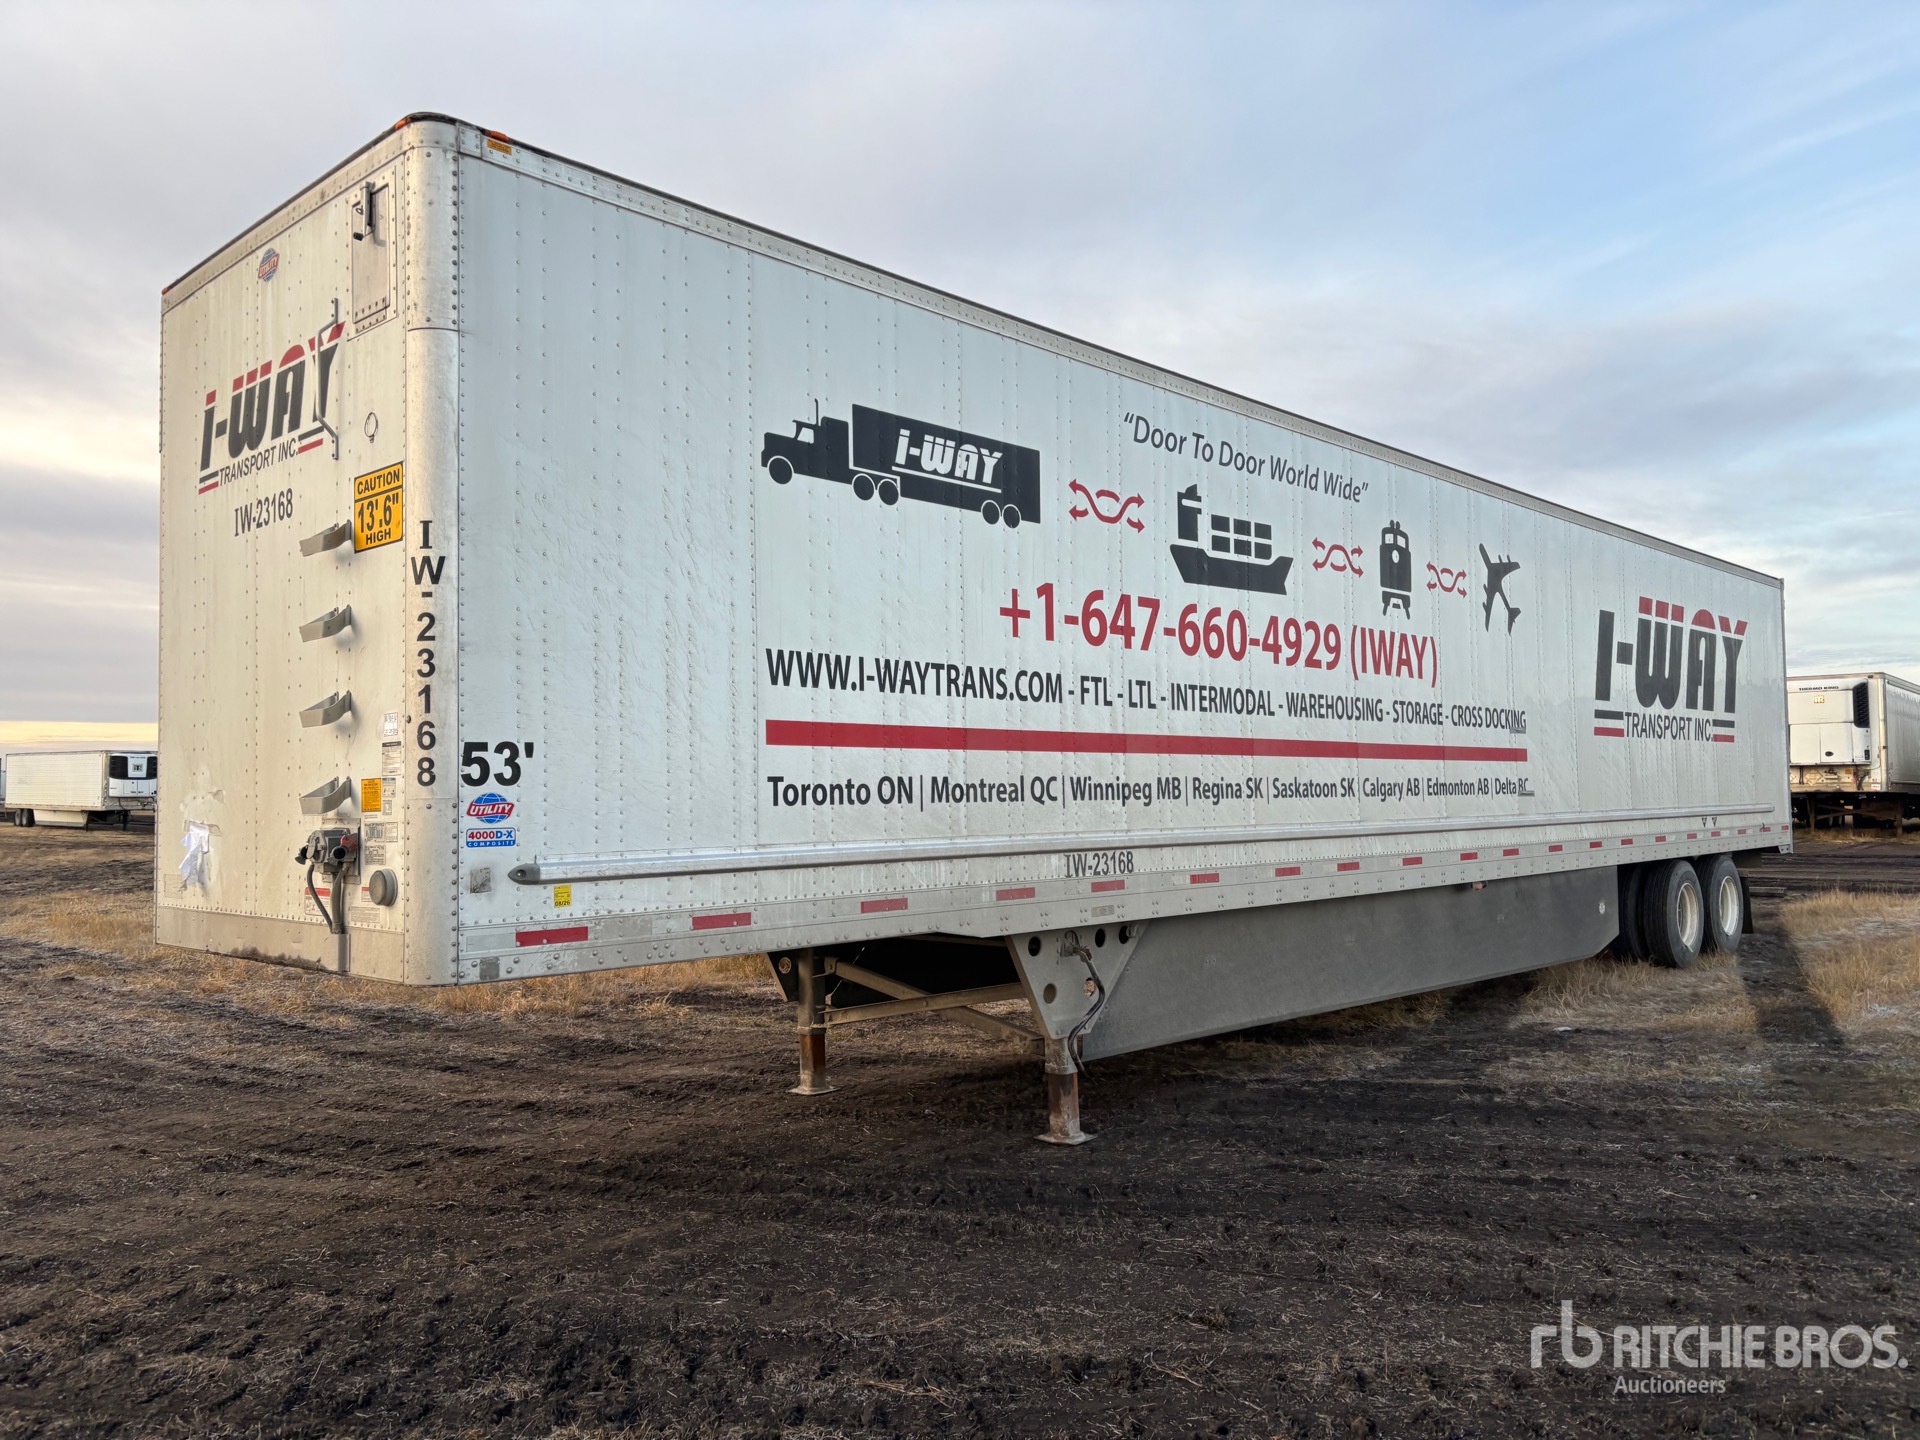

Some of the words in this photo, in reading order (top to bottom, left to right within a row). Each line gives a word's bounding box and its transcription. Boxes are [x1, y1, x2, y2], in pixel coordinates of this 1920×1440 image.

[219, 448, 275, 487] TRANSPORT
[1191, 432, 1214, 462] To
[1219, 440, 1265, 476] Door
[1270, 455, 1319, 492] World
[357, 467, 401, 496] CAUTION
[234, 488, 294, 537] IW-23168
[365, 527, 392, 545] HIGH
[1000, 582, 1341, 671] +1-647-660-4929
[1350, 625, 1438, 689] (IWAY)
[765, 648, 1063, 704] WWW.I-WAYTRANS.COM
[1080, 675, 1112, 707] FTL
[1128, 679, 1156, 710] LTL
[1171, 682, 1275, 717] INTERMODAL
[1286, 691, 1383, 722] WAREHOUSING
[1392, 700, 1443, 727] STORAGE
[1451, 704, 1483, 728] CROSS
[1485, 707, 1526, 730] DOCKING
[1624, 711, 1692, 741] TRANSPORT
[1694, 717, 1713, 742] INC.
[767, 776, 871, 807] Toronto
[877, 776, 913, 804] ON
[930, 775, 1024, 804] Montreal
[1030, 776, 1057, 806] QC
[1070, 776, 1152, 807] Winnipeg
[1157, 776, 1182, 800] MB
[1192, 776, 1242, 804] Regina
[1246, 777, 1264, 799] SK
[1273, 777, 1338, 799] Saskatoon
[1340, 778, 1355, 797] SK
[1362, 778, 1403, 802] Calgary
[1406, 778, 1420, 797] AB
[1426, 778, 1475, 797] Edmonton
[1477, 777, 1490, 796] AB
[1495, 777, 1517, 795] Delta
[470, 803, 512, 816] UTILITY
[468, 830, 514, 840] 4000D-X
[1063, 851, 1134, 878] IW-23168
